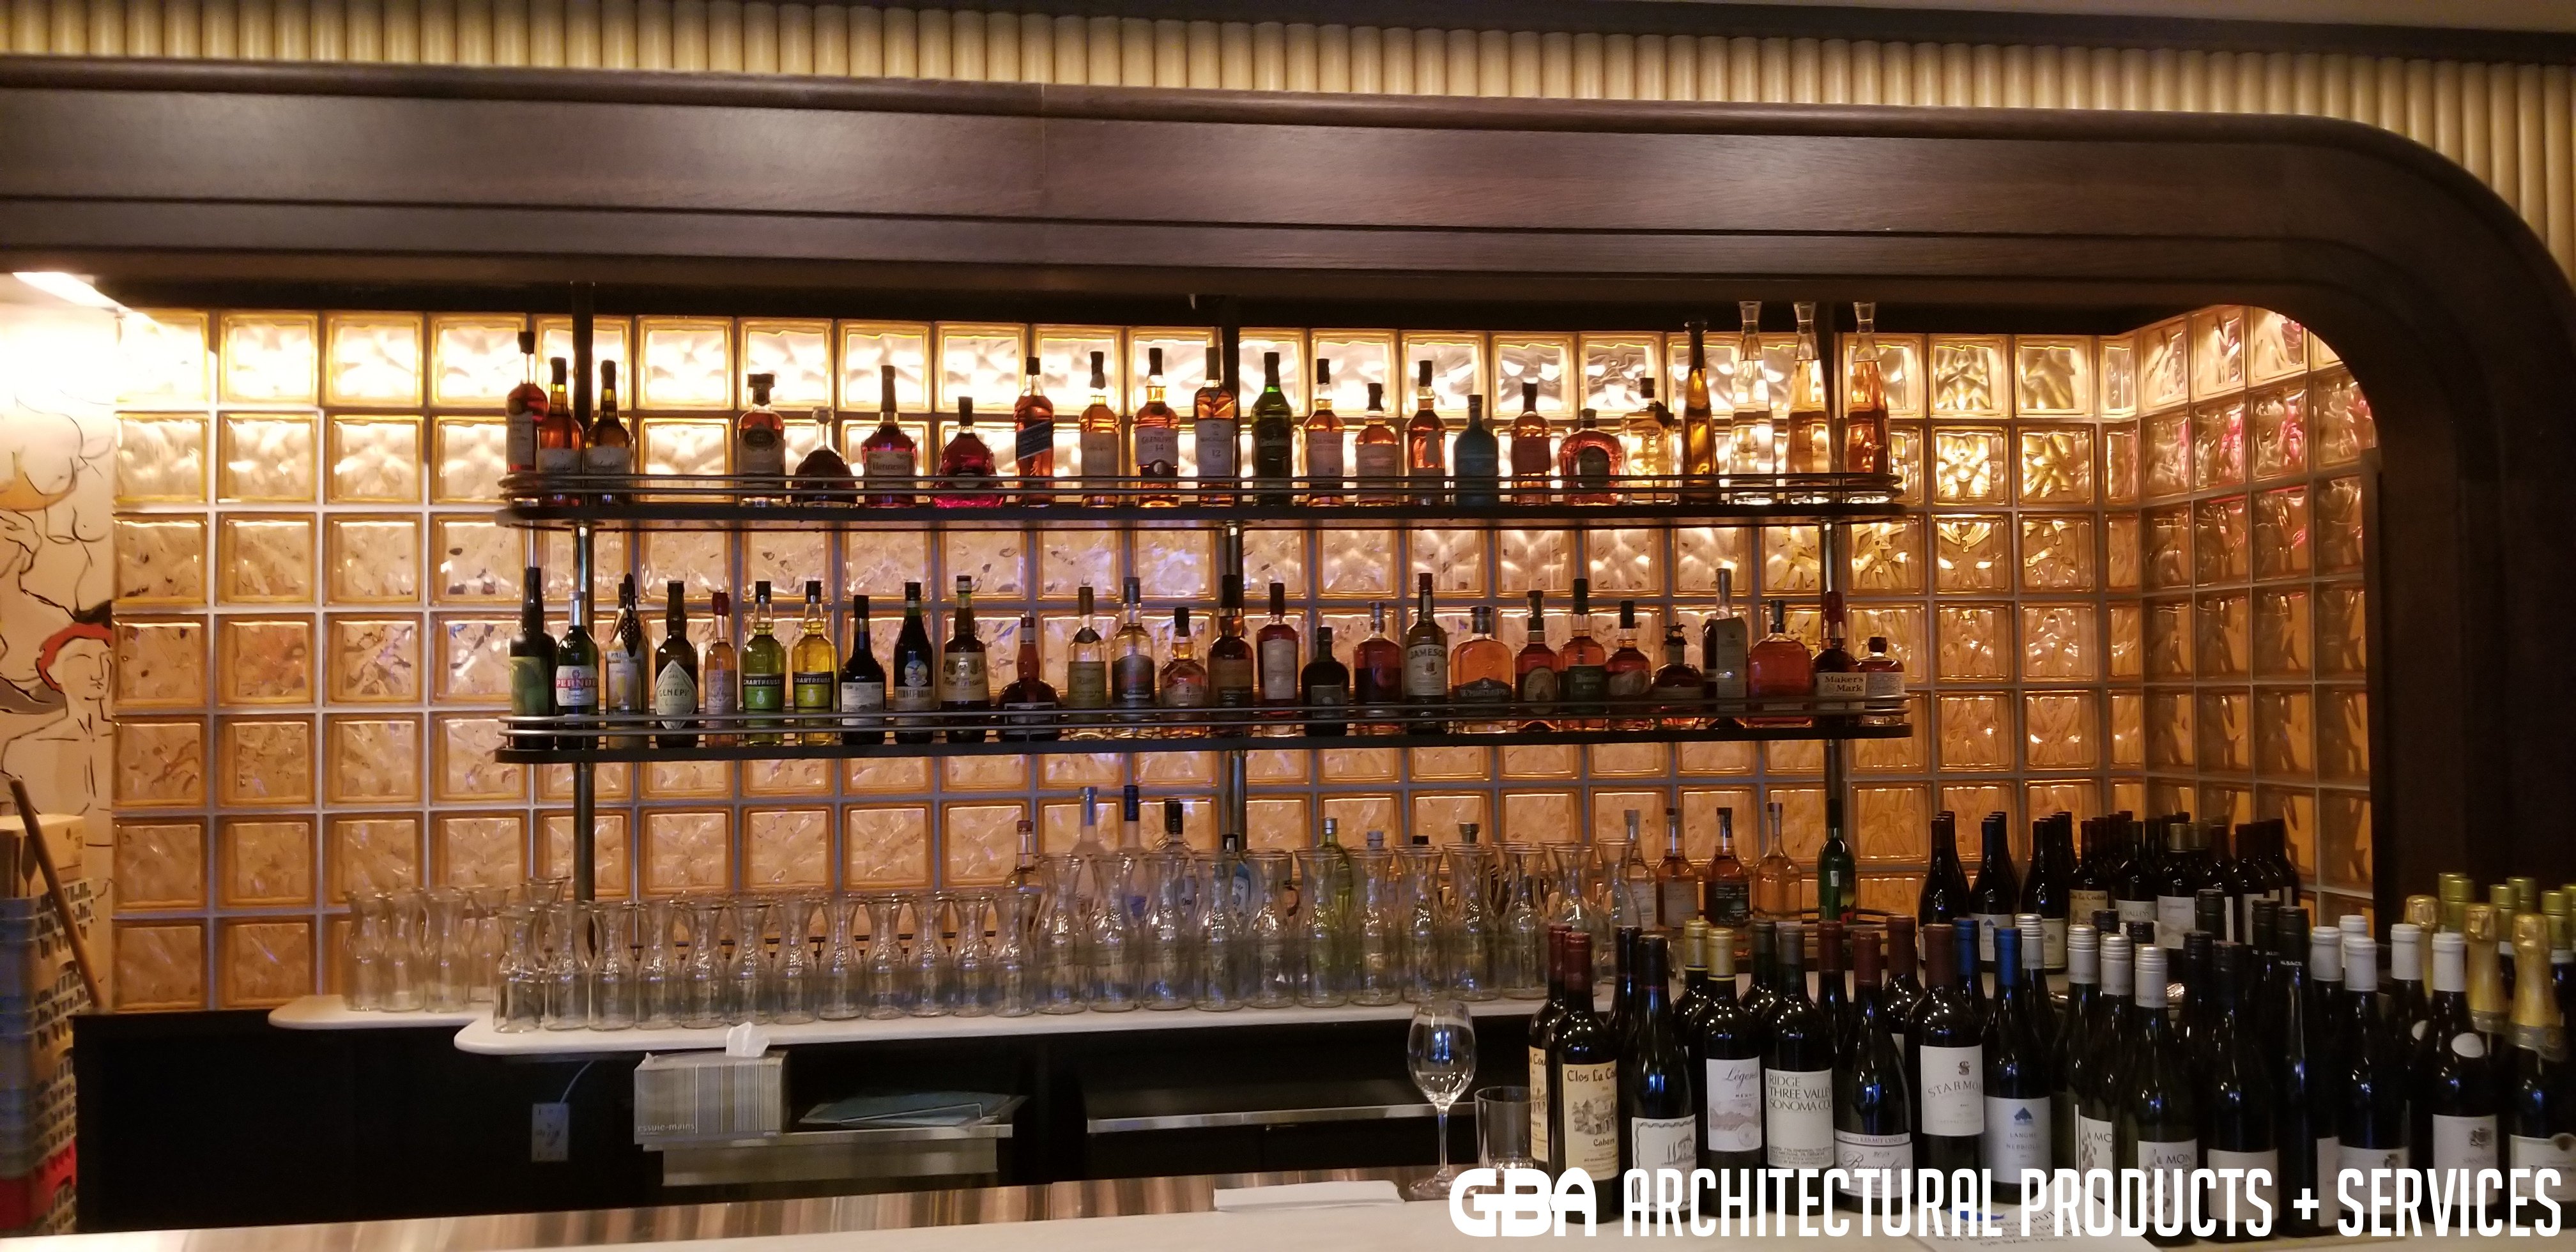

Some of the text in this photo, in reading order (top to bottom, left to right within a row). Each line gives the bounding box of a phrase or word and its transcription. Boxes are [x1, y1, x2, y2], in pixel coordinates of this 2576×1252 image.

[1211, 448, 1222, 457] 12
[1567, 1069, 1589, 1082] Clos
[1593, 1068, 1603, 1082] La
[1769, 1074, 1800, 1087] RIDGE
[1769, 1087, 1800, 1099] THREE
[1769, 1099, 1816, 1111] SONOMA
